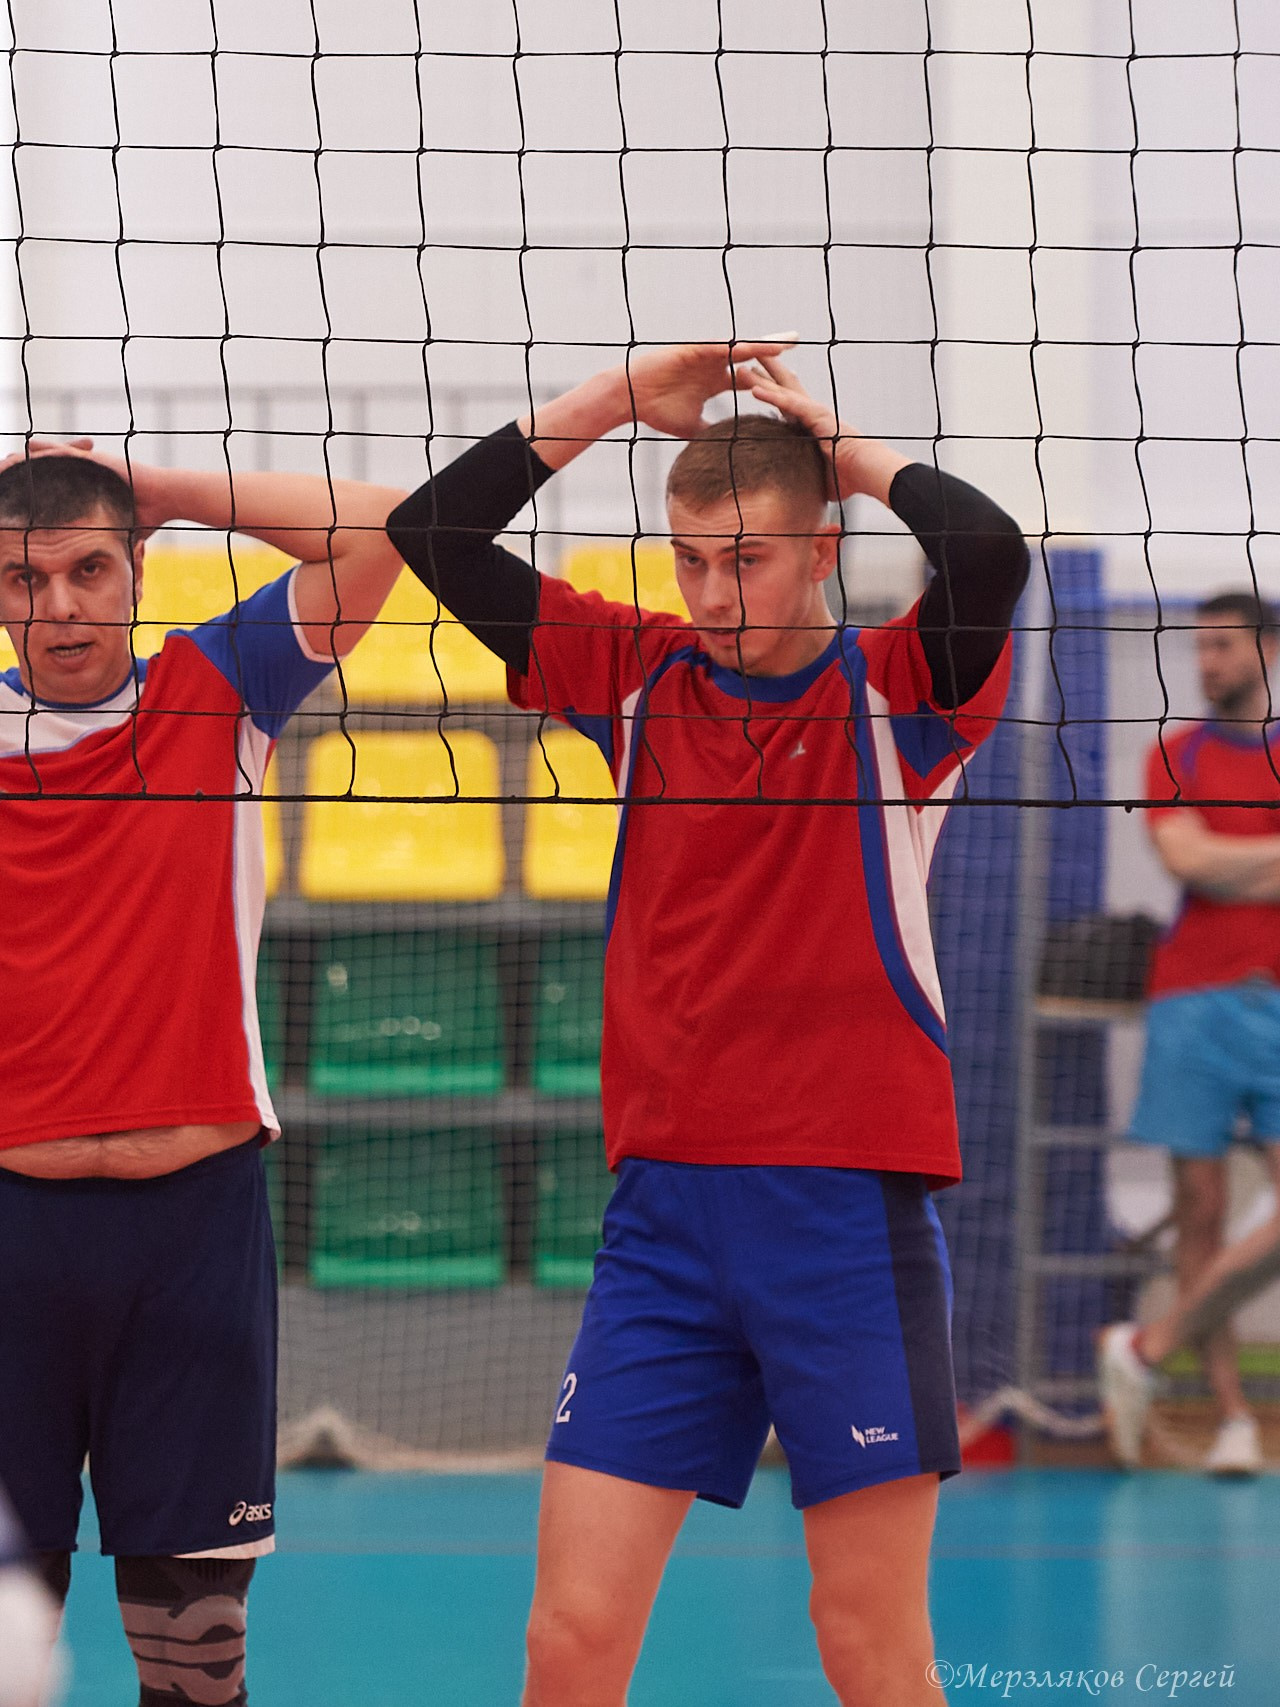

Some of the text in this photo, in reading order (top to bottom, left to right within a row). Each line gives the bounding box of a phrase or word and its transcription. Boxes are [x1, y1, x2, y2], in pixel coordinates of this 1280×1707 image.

[555, 1372, 578, 1424] 2
[865, 1426, 886, 1436] NEW
[866, 1432, 899, 1444] LEAGUE
[244, 1502, 273, 1523] asics
